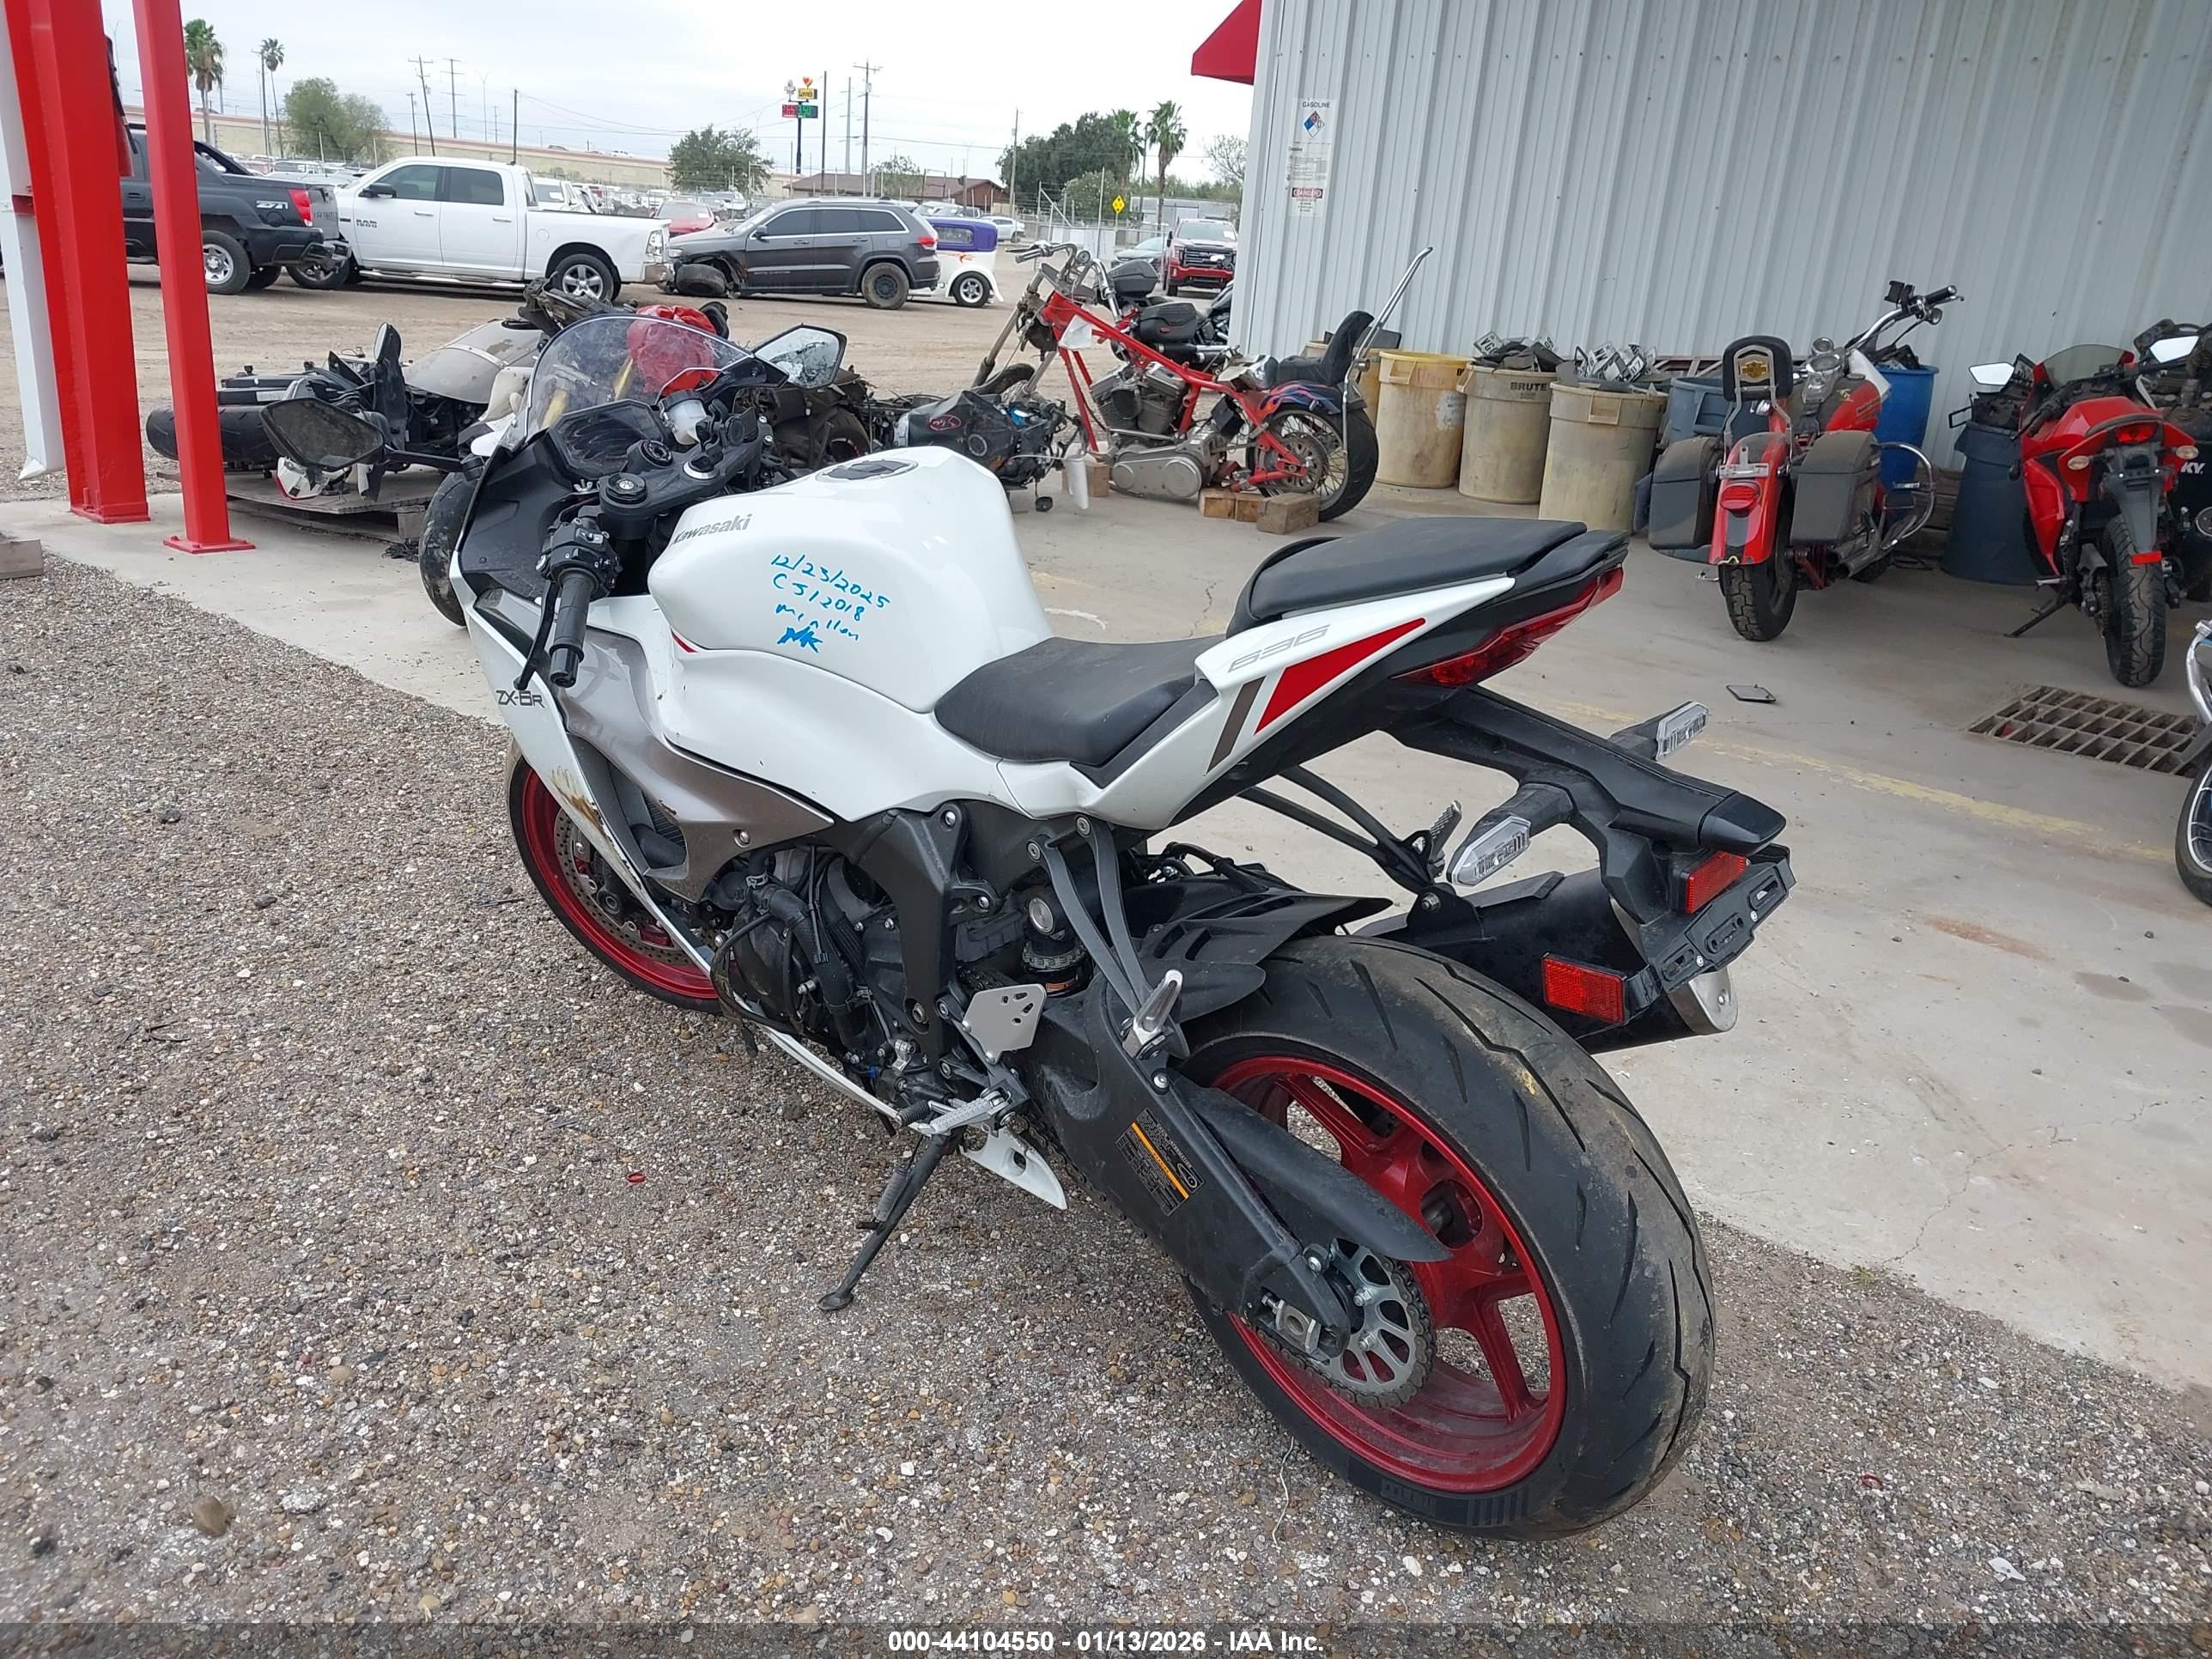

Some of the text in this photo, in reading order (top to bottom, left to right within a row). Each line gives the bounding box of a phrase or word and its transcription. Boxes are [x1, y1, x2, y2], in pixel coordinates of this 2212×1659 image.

[256, 200, 289, 210] Z71
[1510, 381, 1547, 392] BRUTE
[671, 514, 753, 545] Kawasaki
[771, 554, 890, 608] 12/23/2025
[1228, 624, 1330, 673] 636
[495, 690, 545, 708] ZX-6R
